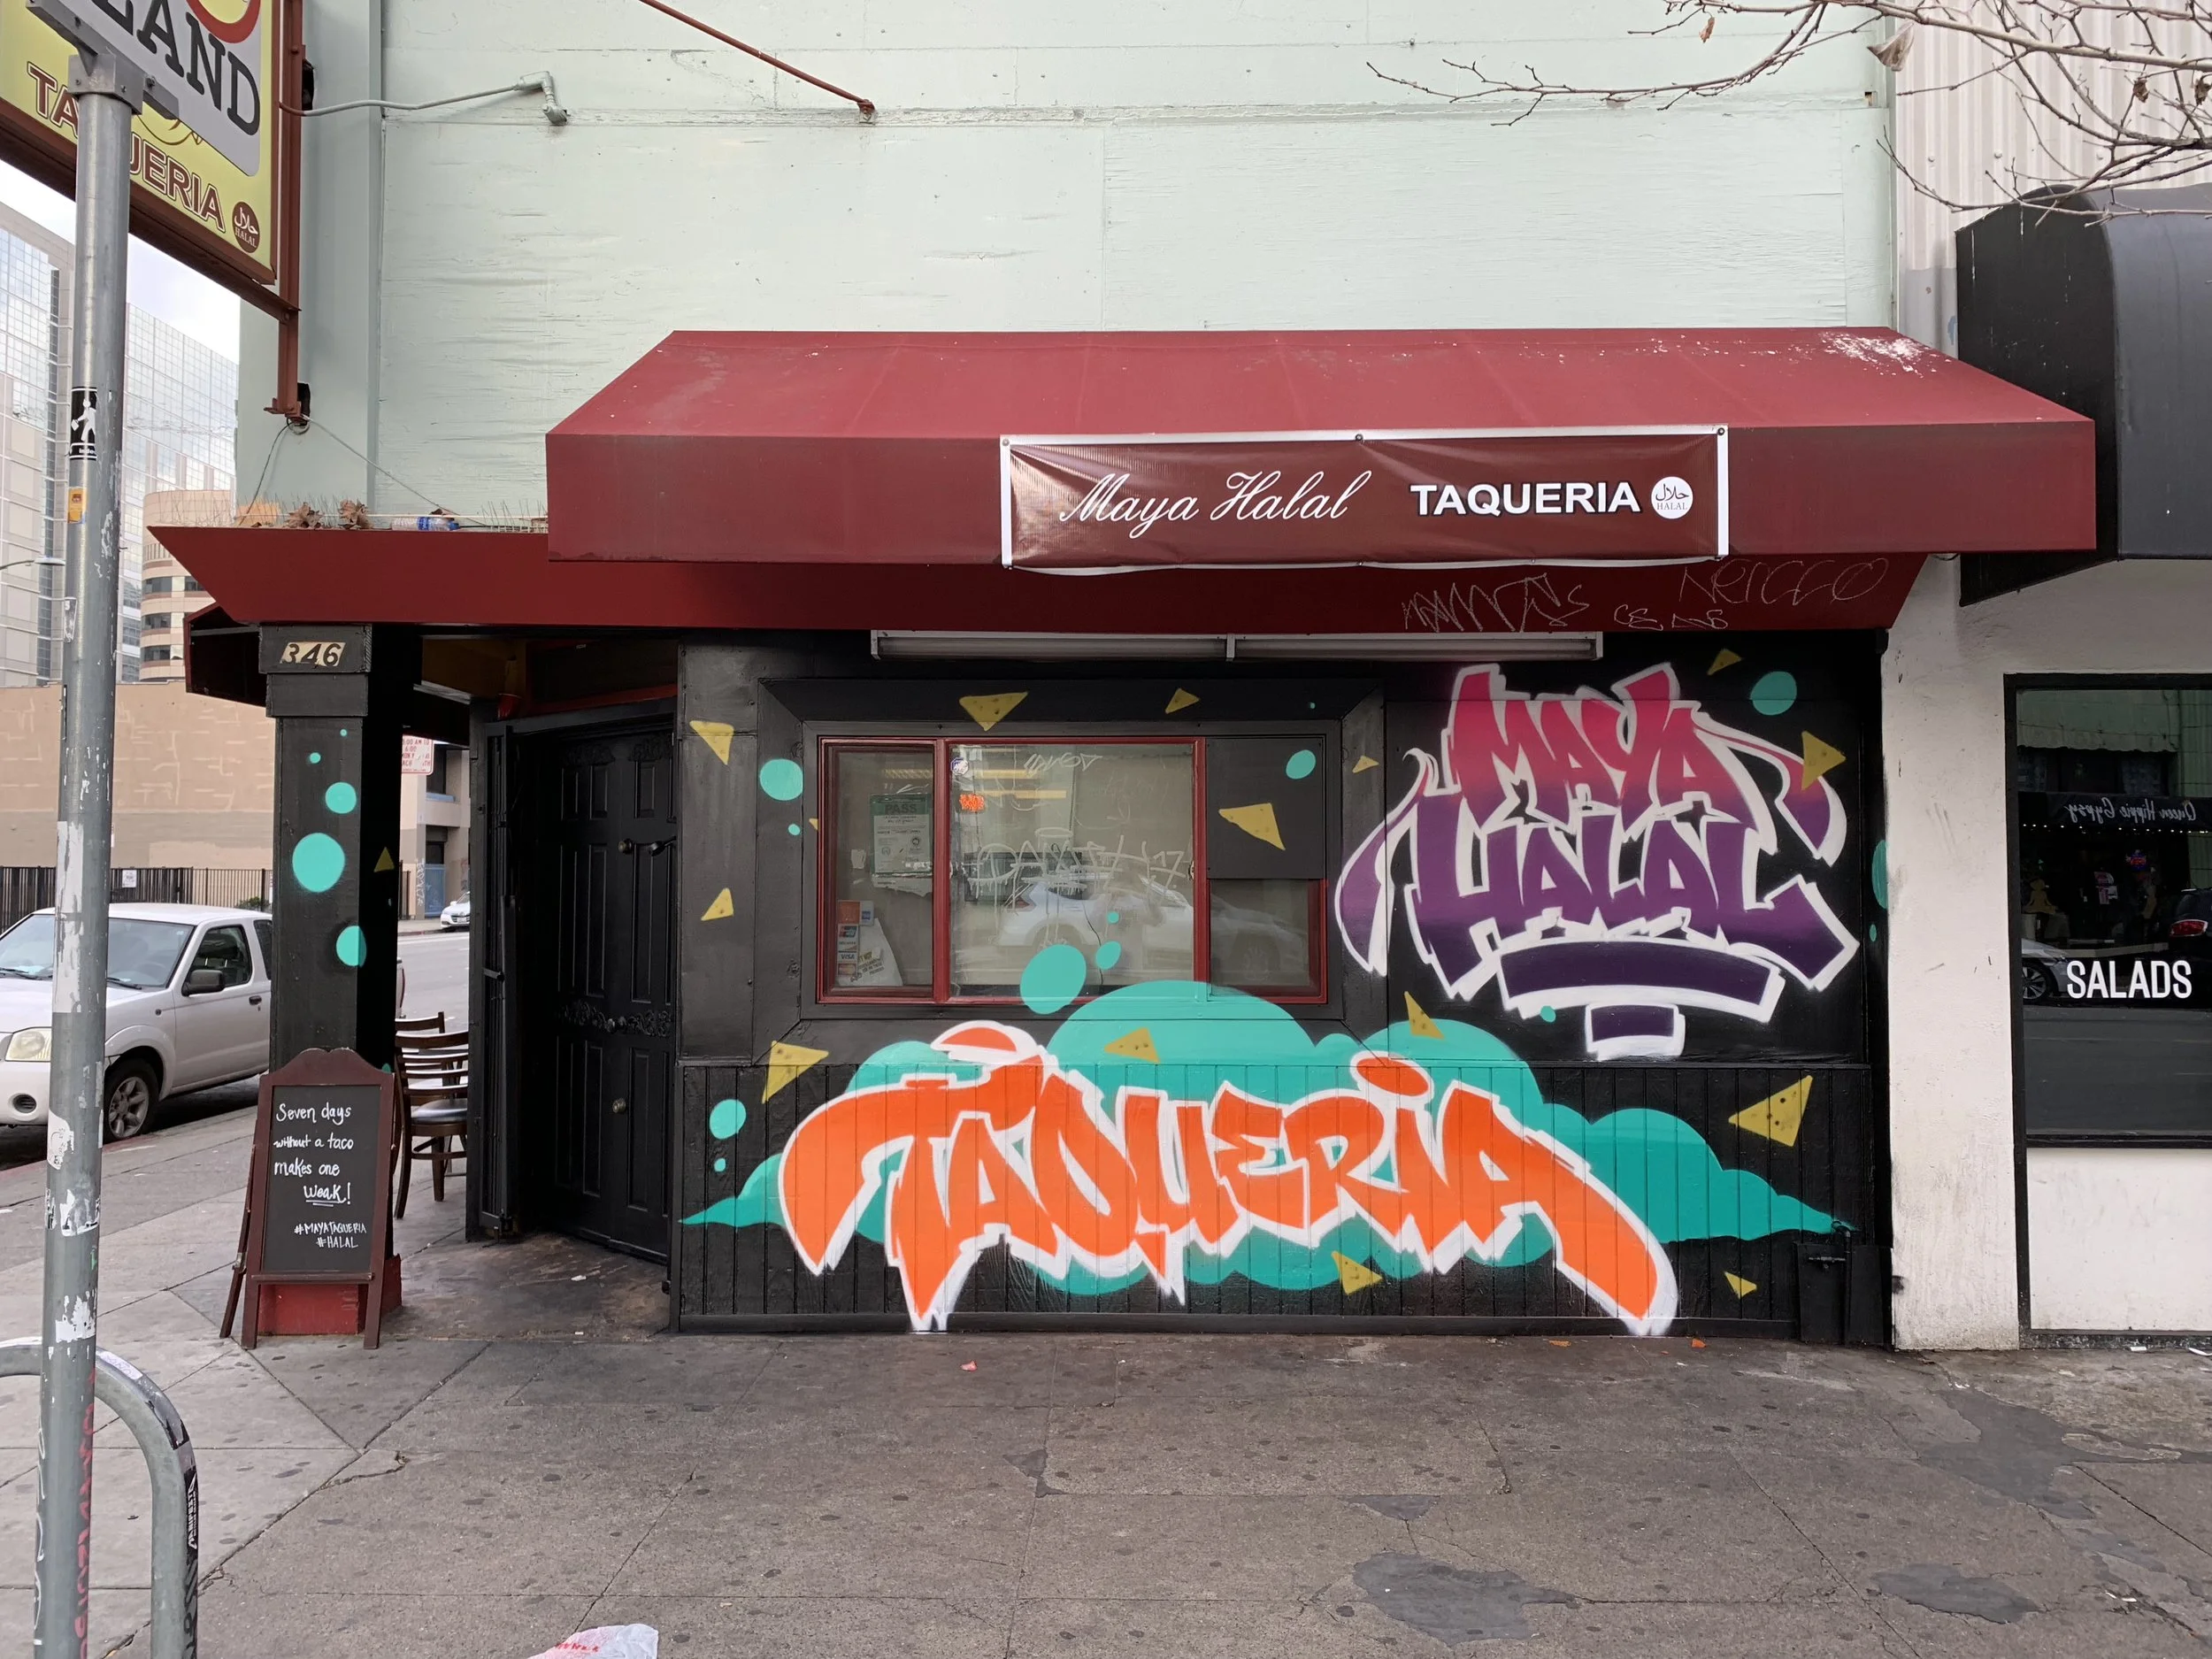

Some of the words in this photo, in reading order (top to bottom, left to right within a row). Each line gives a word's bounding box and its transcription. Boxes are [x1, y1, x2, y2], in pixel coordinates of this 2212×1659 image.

[234, 207, 258, 234] حلال
[234, 227, 257, 248] HALAL
[1655, 483, 1689, 501] حلال
[1059, 472, 1200, 539] Maya
[1210, 470, 1372, 520] Halal
[1409, 481, 1641, 517] TAQUERIA
[1656, 502, 1687, 511] HALAL
[282, 643, 342, 666] 346
[1440, 663, 1847, 854] MAYA
[885, 803, 918, 815] PASS
[1334, 792, 1859, 1002] HALAL
[2066, 960, 2192, 999] SALADS
[276, 1102, 317, 1124] Seven
[321, 1102, 352, 1125] days
[273, 1133, 311, 1148] without
[314, 1138, 325, 1148] a
[327, 1132, 354, 1149] taco
[274, 1156, 312, 1178] makes
[319, 1164, 341, 1177] one
[779, 1020, 1677, 1338] TAQUERIA
[294, 1221, 367, 1235] #MAYATAQUERIA
[316, 1235, 359, 1248] #HALAL
